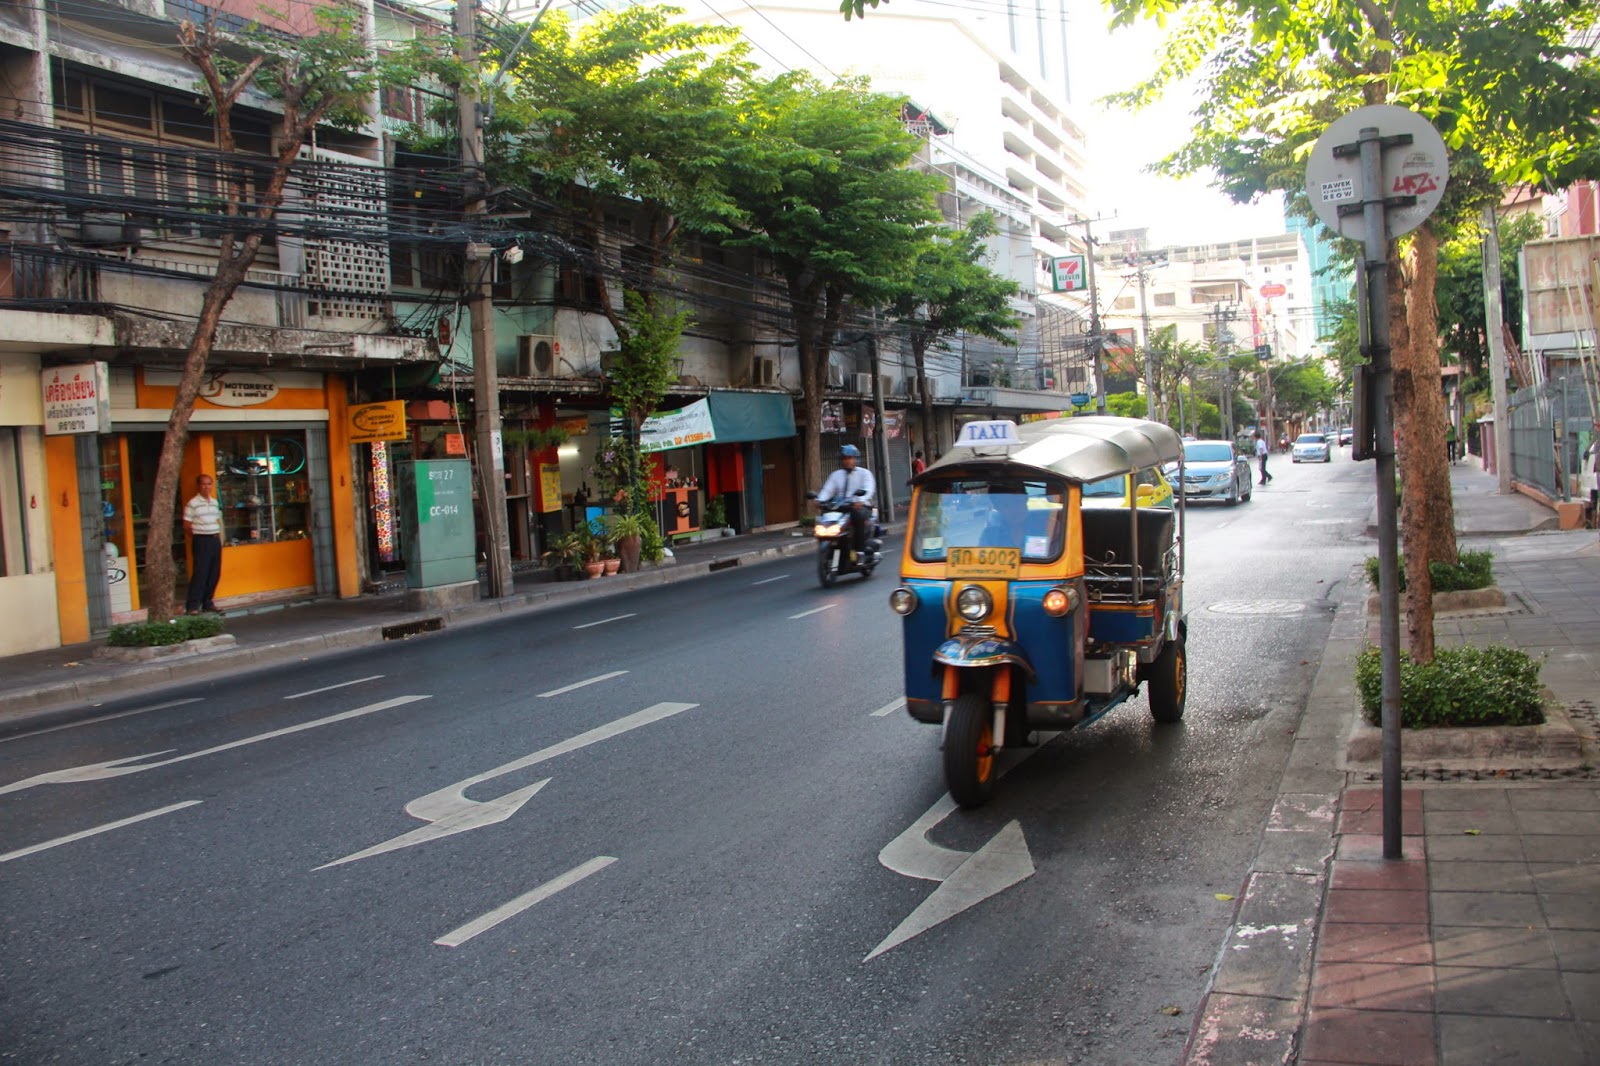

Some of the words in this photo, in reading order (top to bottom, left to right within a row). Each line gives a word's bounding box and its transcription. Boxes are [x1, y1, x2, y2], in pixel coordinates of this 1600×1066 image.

[224, 382, 274, 391] MOTORBIKE
[967, 424, 1008, 440] TAXI
[430, 505, 458, 516] CC-014
[979, 549, 1017, 565] 6002
